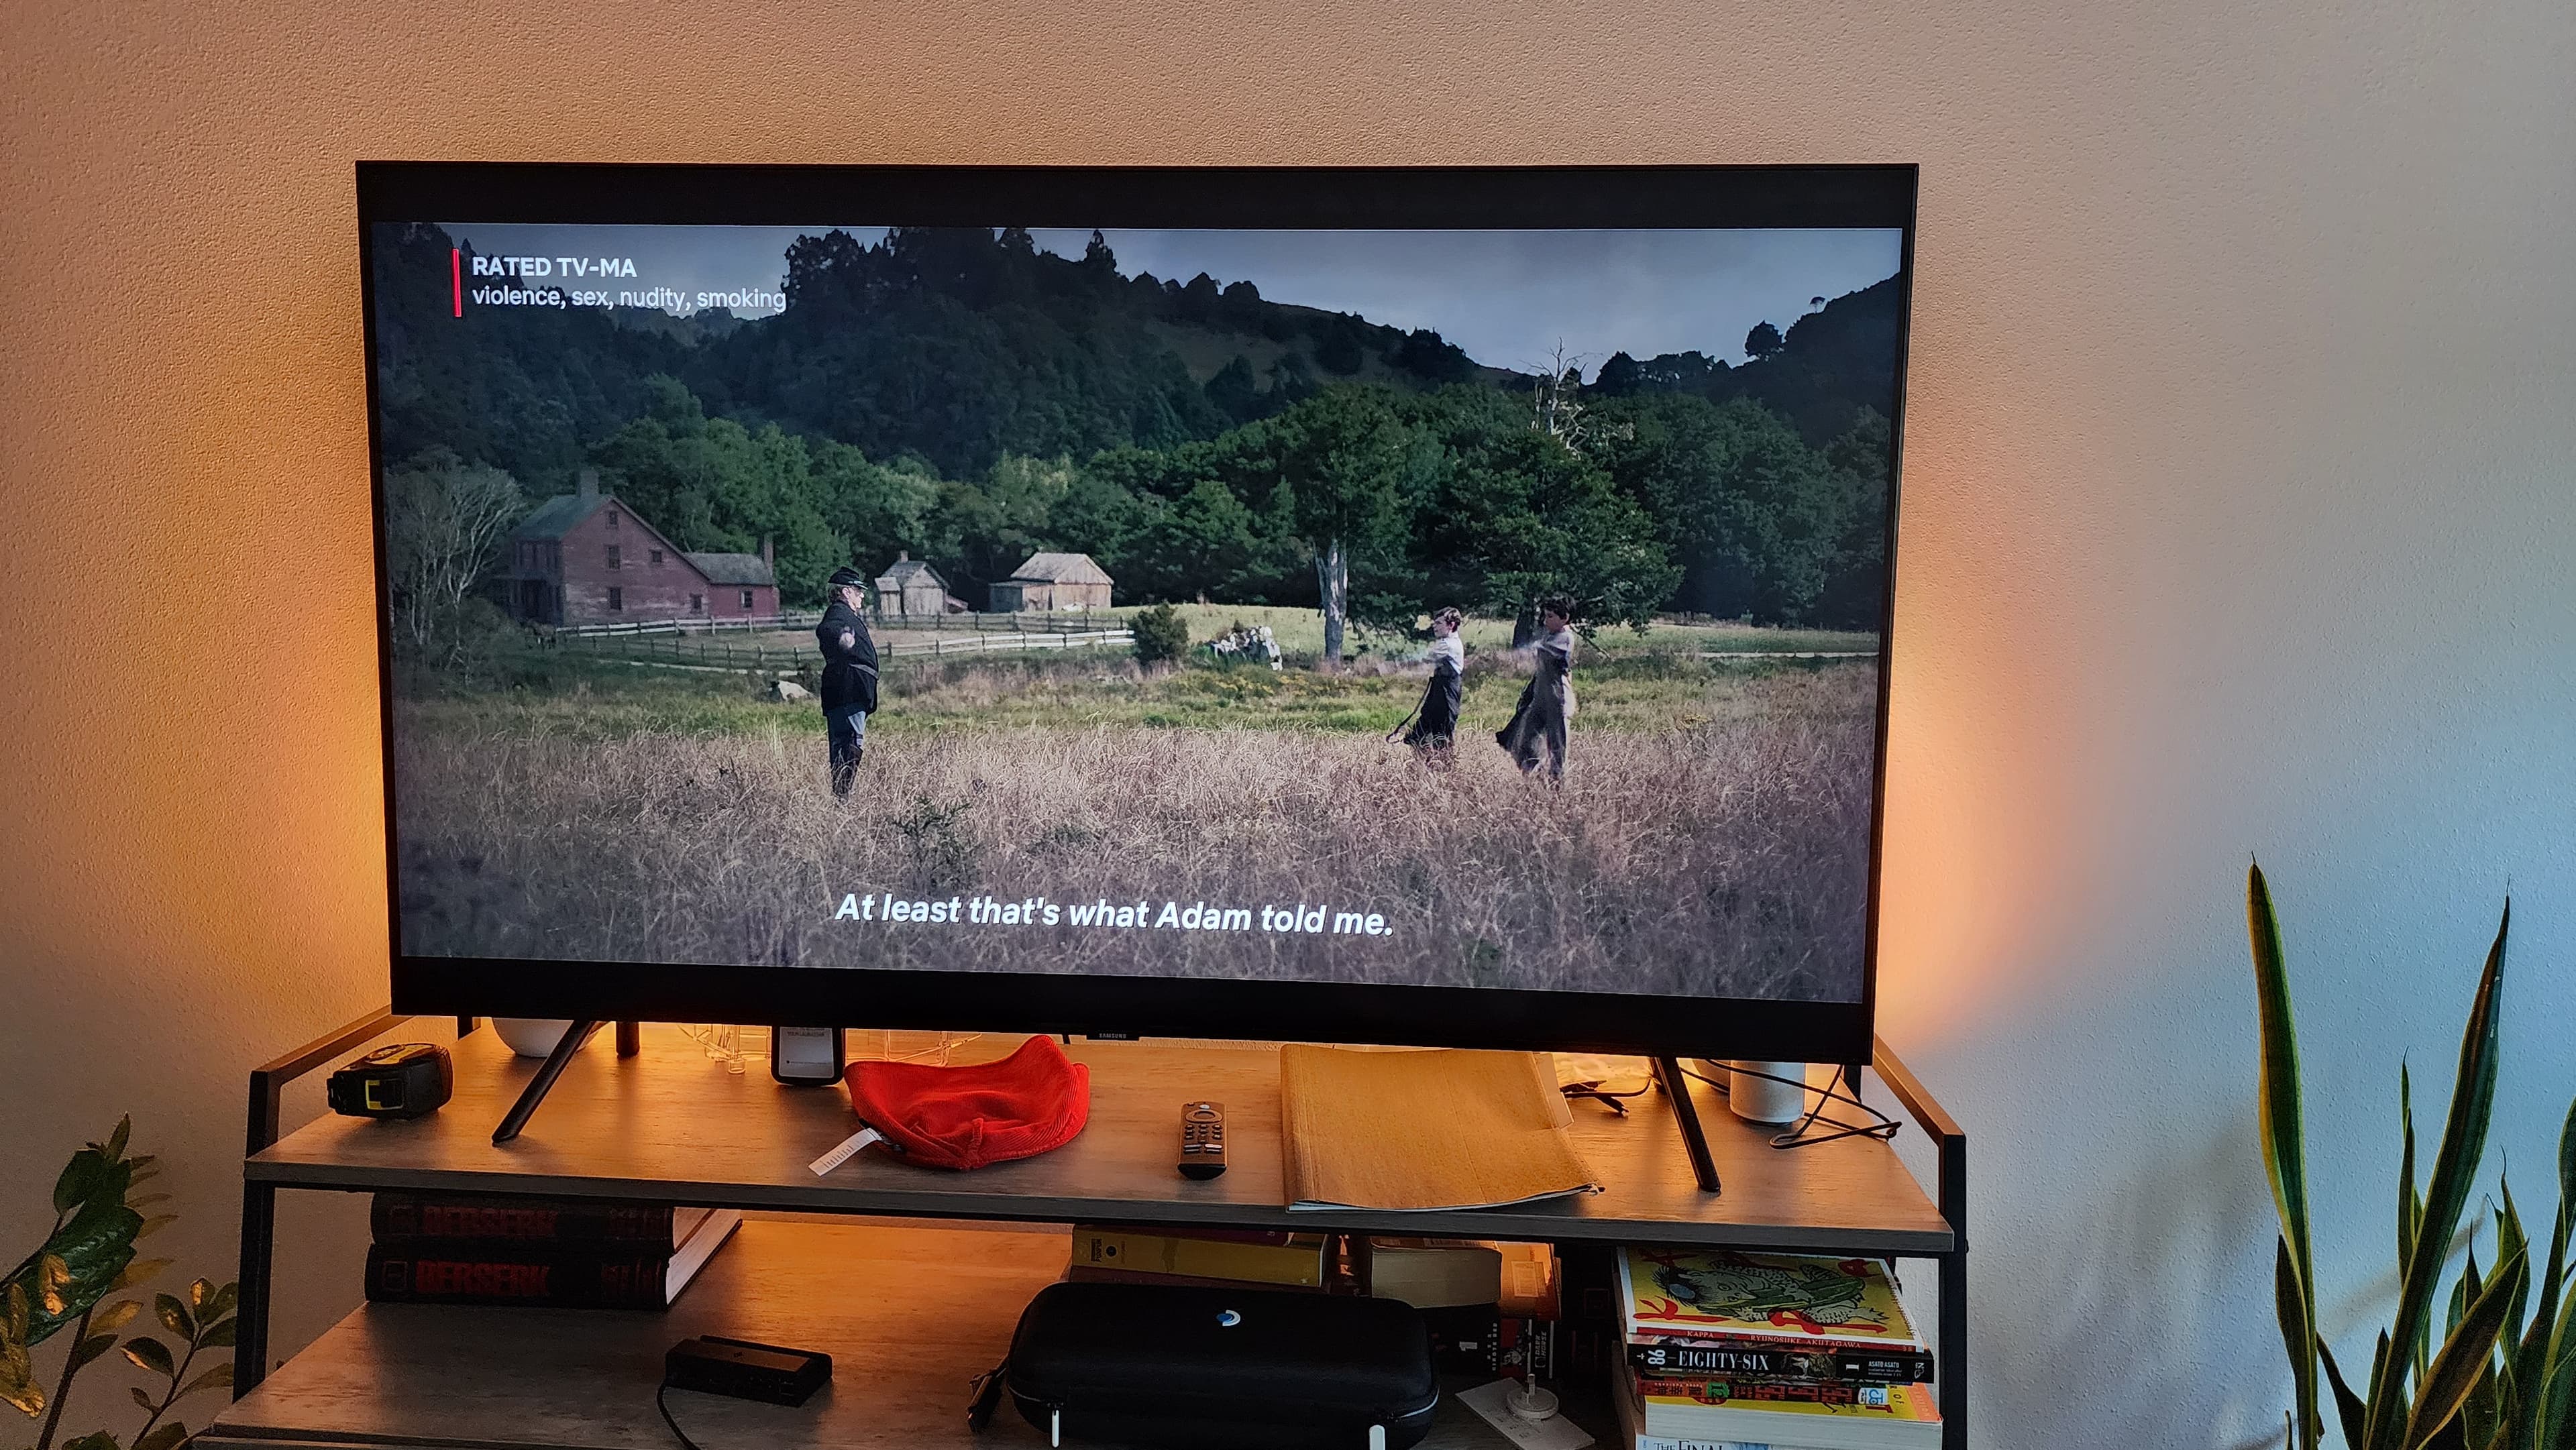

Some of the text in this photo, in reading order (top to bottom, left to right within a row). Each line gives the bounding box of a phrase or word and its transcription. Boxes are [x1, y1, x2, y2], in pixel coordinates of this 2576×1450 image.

[474, 256, 637, 278] RATED TV-MA
[472, 285, 787, 313] violence, sex, nudity, smoking
[835, 893, 1395, 936] At least that's what Adam told me.
[415, 1260, 551, 1297] BERSERK
[1805, 1339, 1862, 1349] AKUTAGAWA
[1648, 1349, 1666, 1365] 86
[1678, 1350, 1770, 1371] EIGHTY-SIX
[1711, 1384, 1725, 1398] 12
